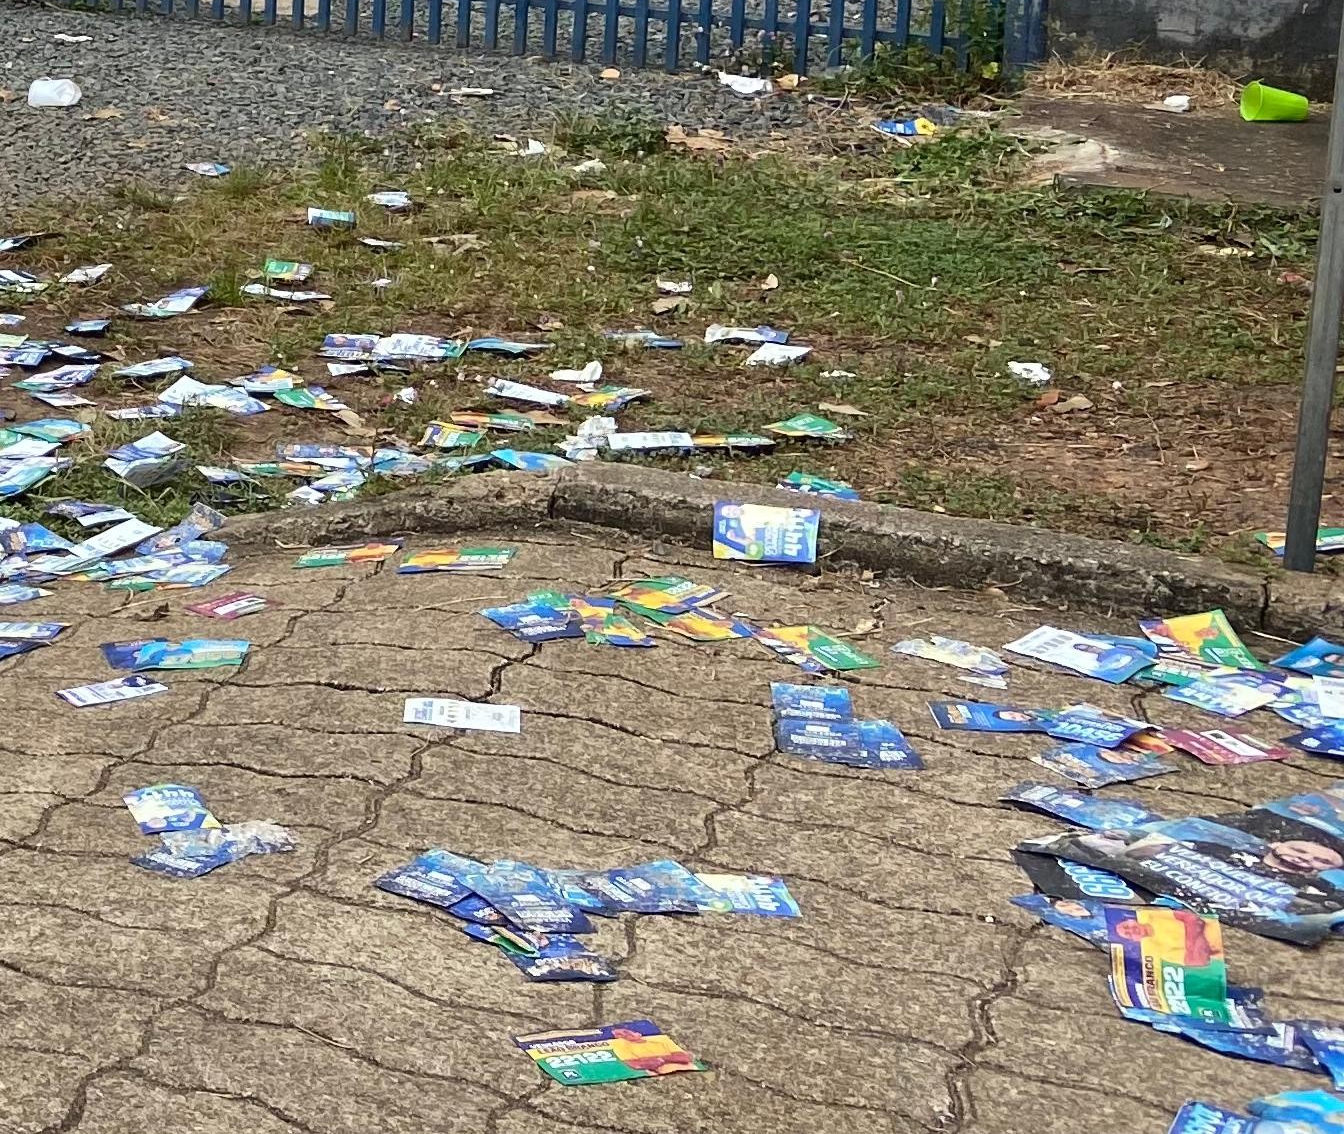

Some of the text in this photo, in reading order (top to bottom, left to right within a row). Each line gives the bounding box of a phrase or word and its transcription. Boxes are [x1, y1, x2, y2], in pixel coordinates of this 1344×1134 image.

[1055, 722, 1124, 744] 10456
[1140, 859, 1169, 874] EU
[1155, 852, 1247, 894] VEREADOR
[544, 1050, 618, 1069] 22122
